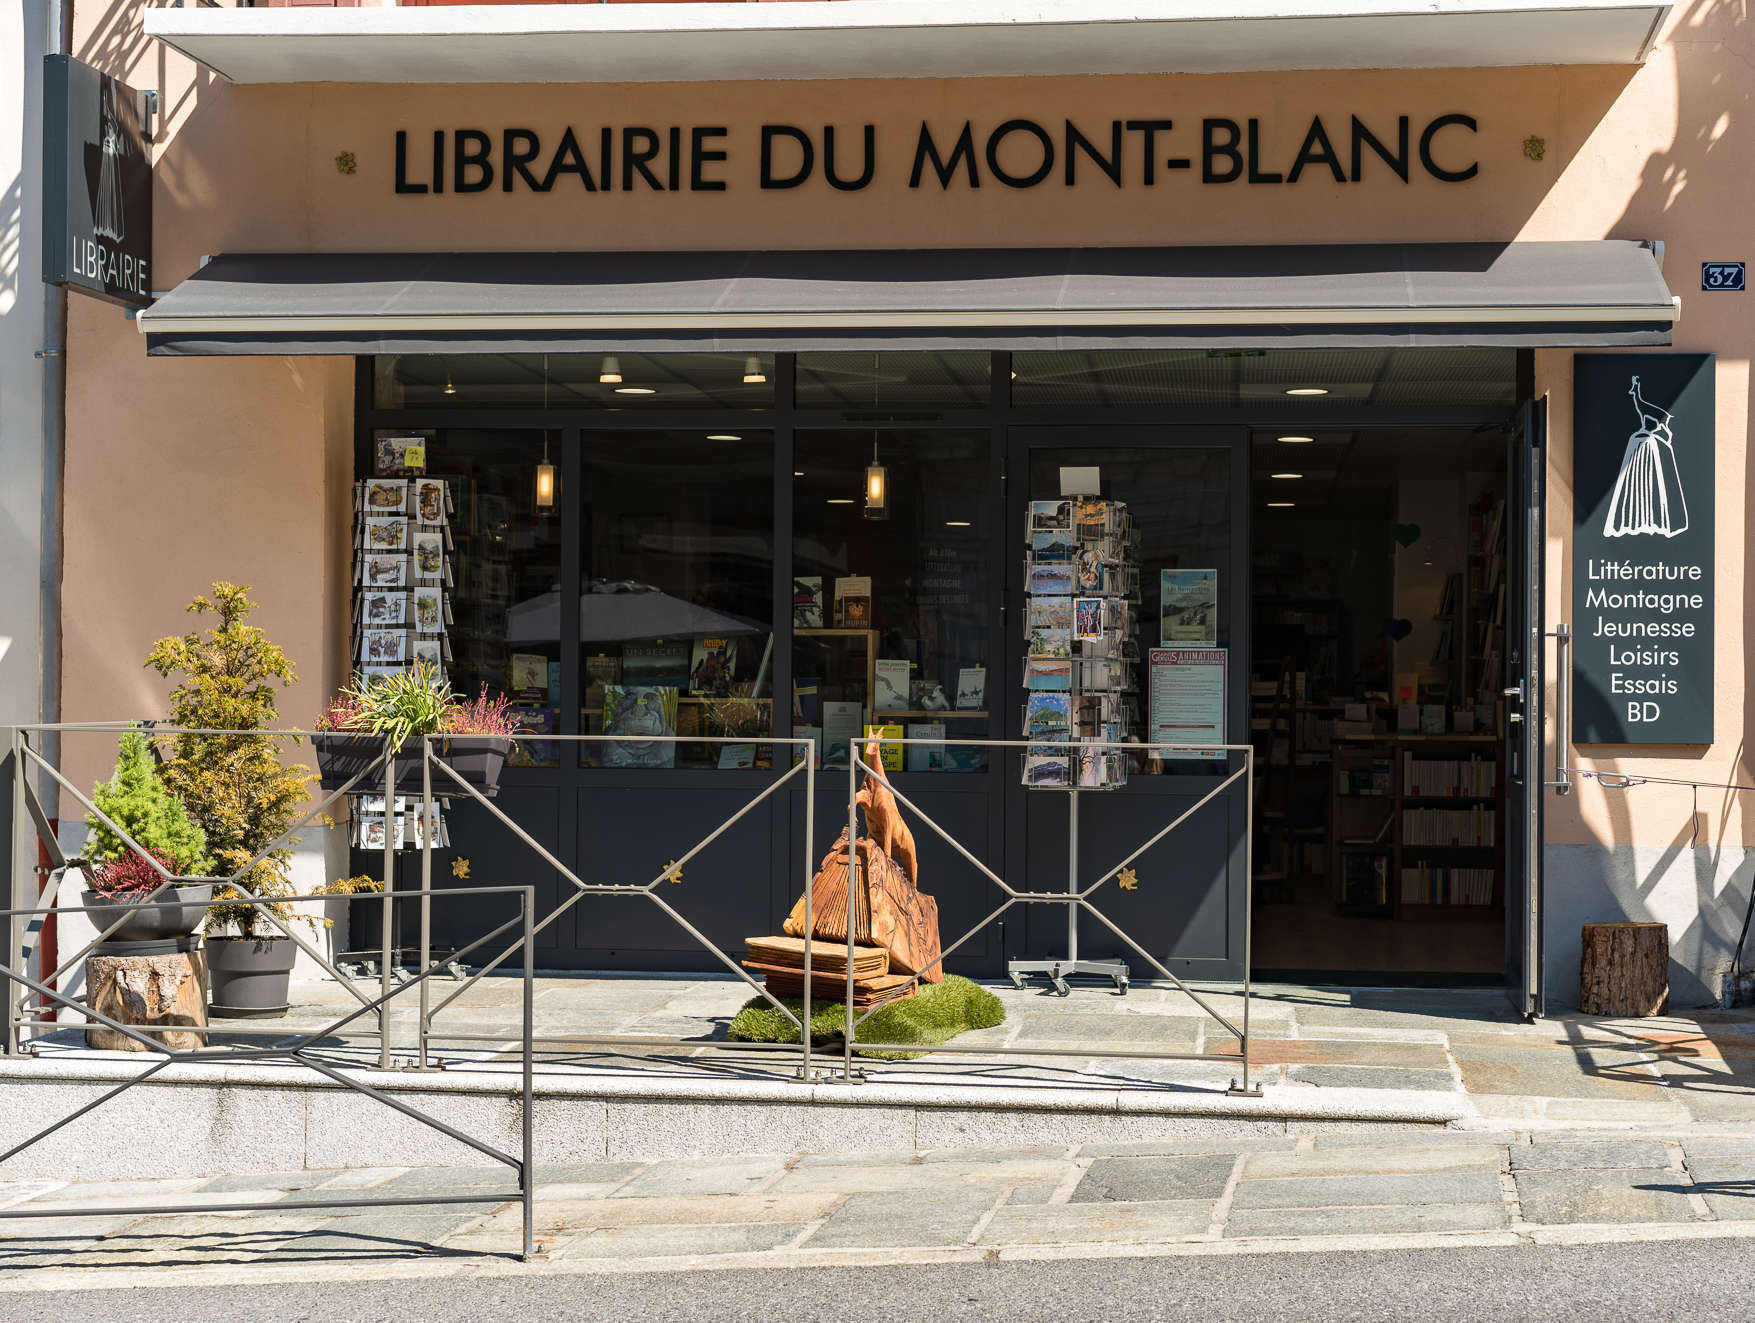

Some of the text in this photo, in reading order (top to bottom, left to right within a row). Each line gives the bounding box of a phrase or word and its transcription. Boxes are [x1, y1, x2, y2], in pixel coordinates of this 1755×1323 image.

[395, 114, 1478, 194] LIBRAIRIE DU MONT-BLANC
[73, 234, 147, 296] LIBRAIRIE
[1709, 267, 1739, 286] 37
[1588, 558, 1702, 581] Littérature
[1585, 587, 1704, 613] Montagne
[1592, 615, 1696, 638] Jeunesse
[1178, 651, 1225, 661] ANIMATIONS
[1610, 644, 1679, 666] Loisirs
[1611, 672, 1678, 695] Essais
[1627, 701, 1661, 723] BD
